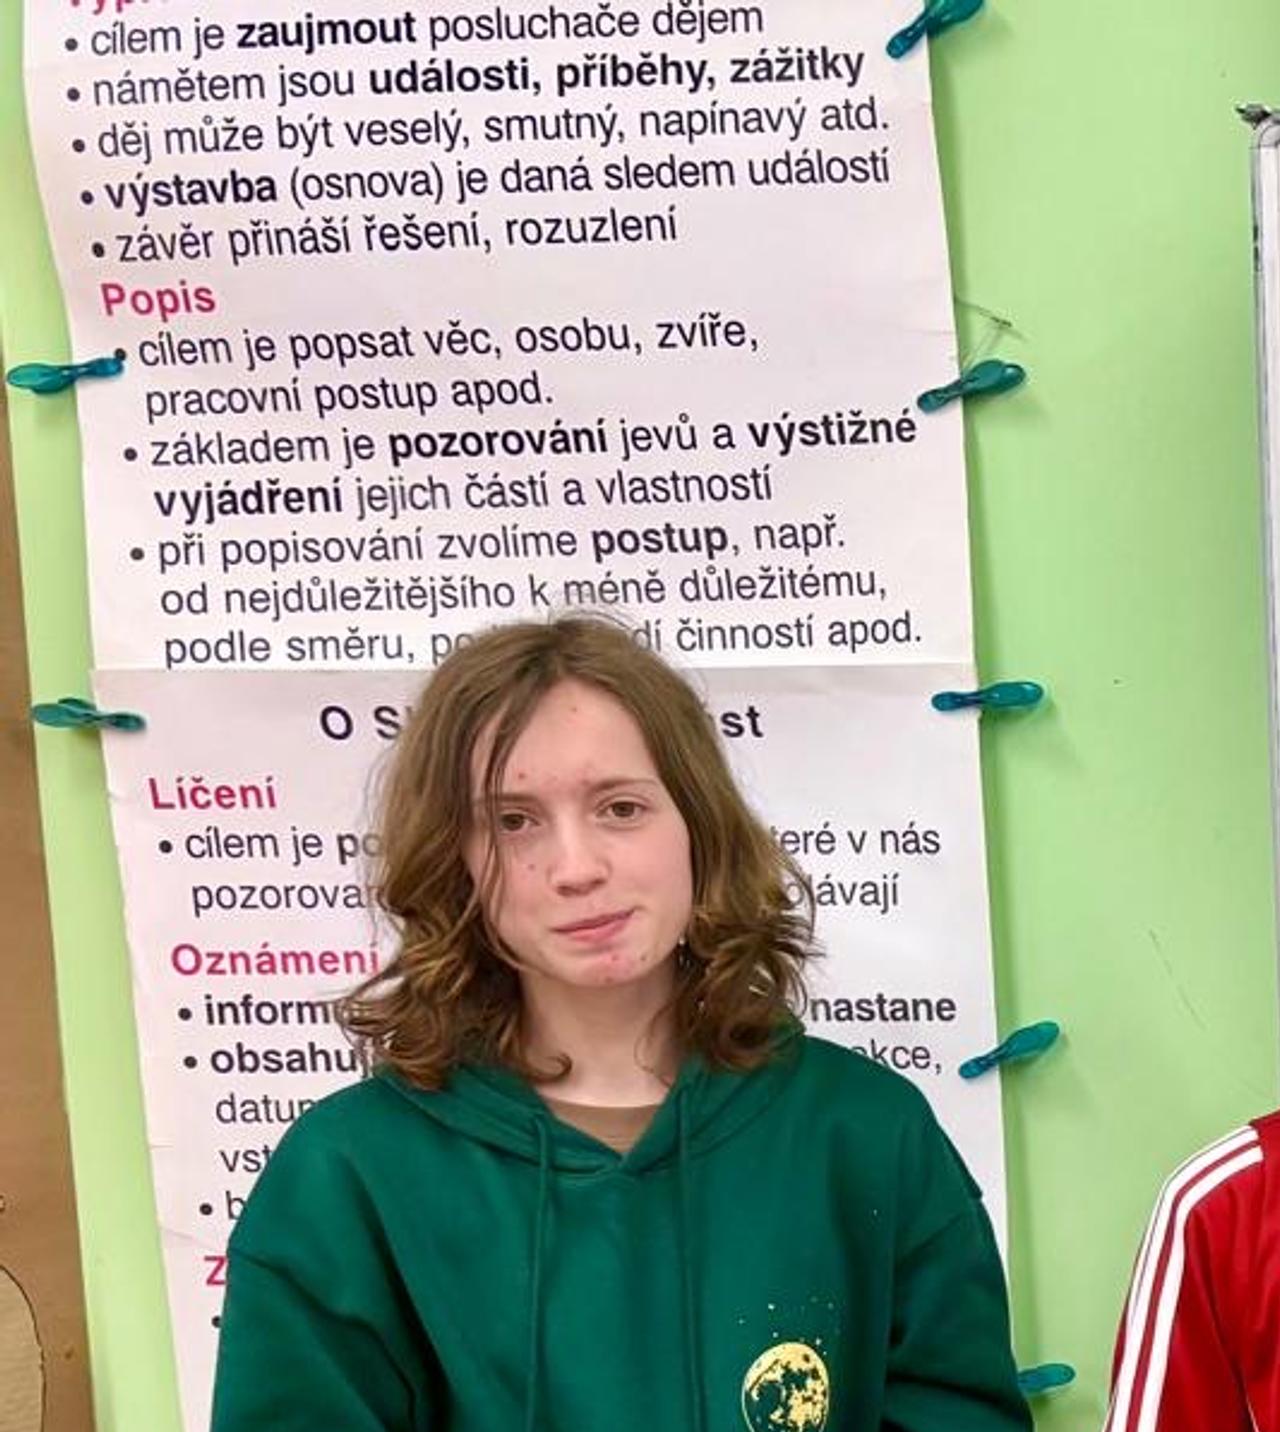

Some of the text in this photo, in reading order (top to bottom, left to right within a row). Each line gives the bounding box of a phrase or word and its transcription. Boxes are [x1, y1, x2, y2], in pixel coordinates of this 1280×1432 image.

[90, 0, 764, 61] cílem je zaujmout posluchače dějem
[93, 45, 865, 108] námětem jsou události, příběhy, zážitky
[97, 94, 890, 166] děj může být veselý, smutný, napínavý atd.
[103, 145, 890, 218] výstavba (osnova) je daná sledem událostí
[115, 203, 678, 267] závěr přináší řešení, rozuzlení
[100, 279, 216, 324] Popis
[138, 311, 758, 373] cílem je popsat věc, osobu, zvíře,
[145, 369, 554, 426] pracovní postup apod.
[149, 407, 918, 471] základem je pozorování jevů a výstižné
[153, 462, 772, 526] vyjádření jejich částí a vlastností
[158, 513, 845, 575] při popisování zvolíme postup, např.
[160, 563, 887, 623] od nejdůležitějšího k méně důležitému,
[164, 629, 271, 671] podle
[287, 626, 414, 663] směru,
[676, 612, 814, 652] činností
[827, 609, 922, 654] apod.
[319, 705, 354, 741] O
[148, 775, 277, 810] Líčení
[184, 825, 280, 860] cílem
[290, 825, 324, 868] je
[771, 820, 942, 856] eré v nás
[785, 872, 900, 915] olávají
[171, 942, 379, 975] Oznámení
[205, 994, 330, 1026] inform
[811, 992, 957, 1023] nastane
